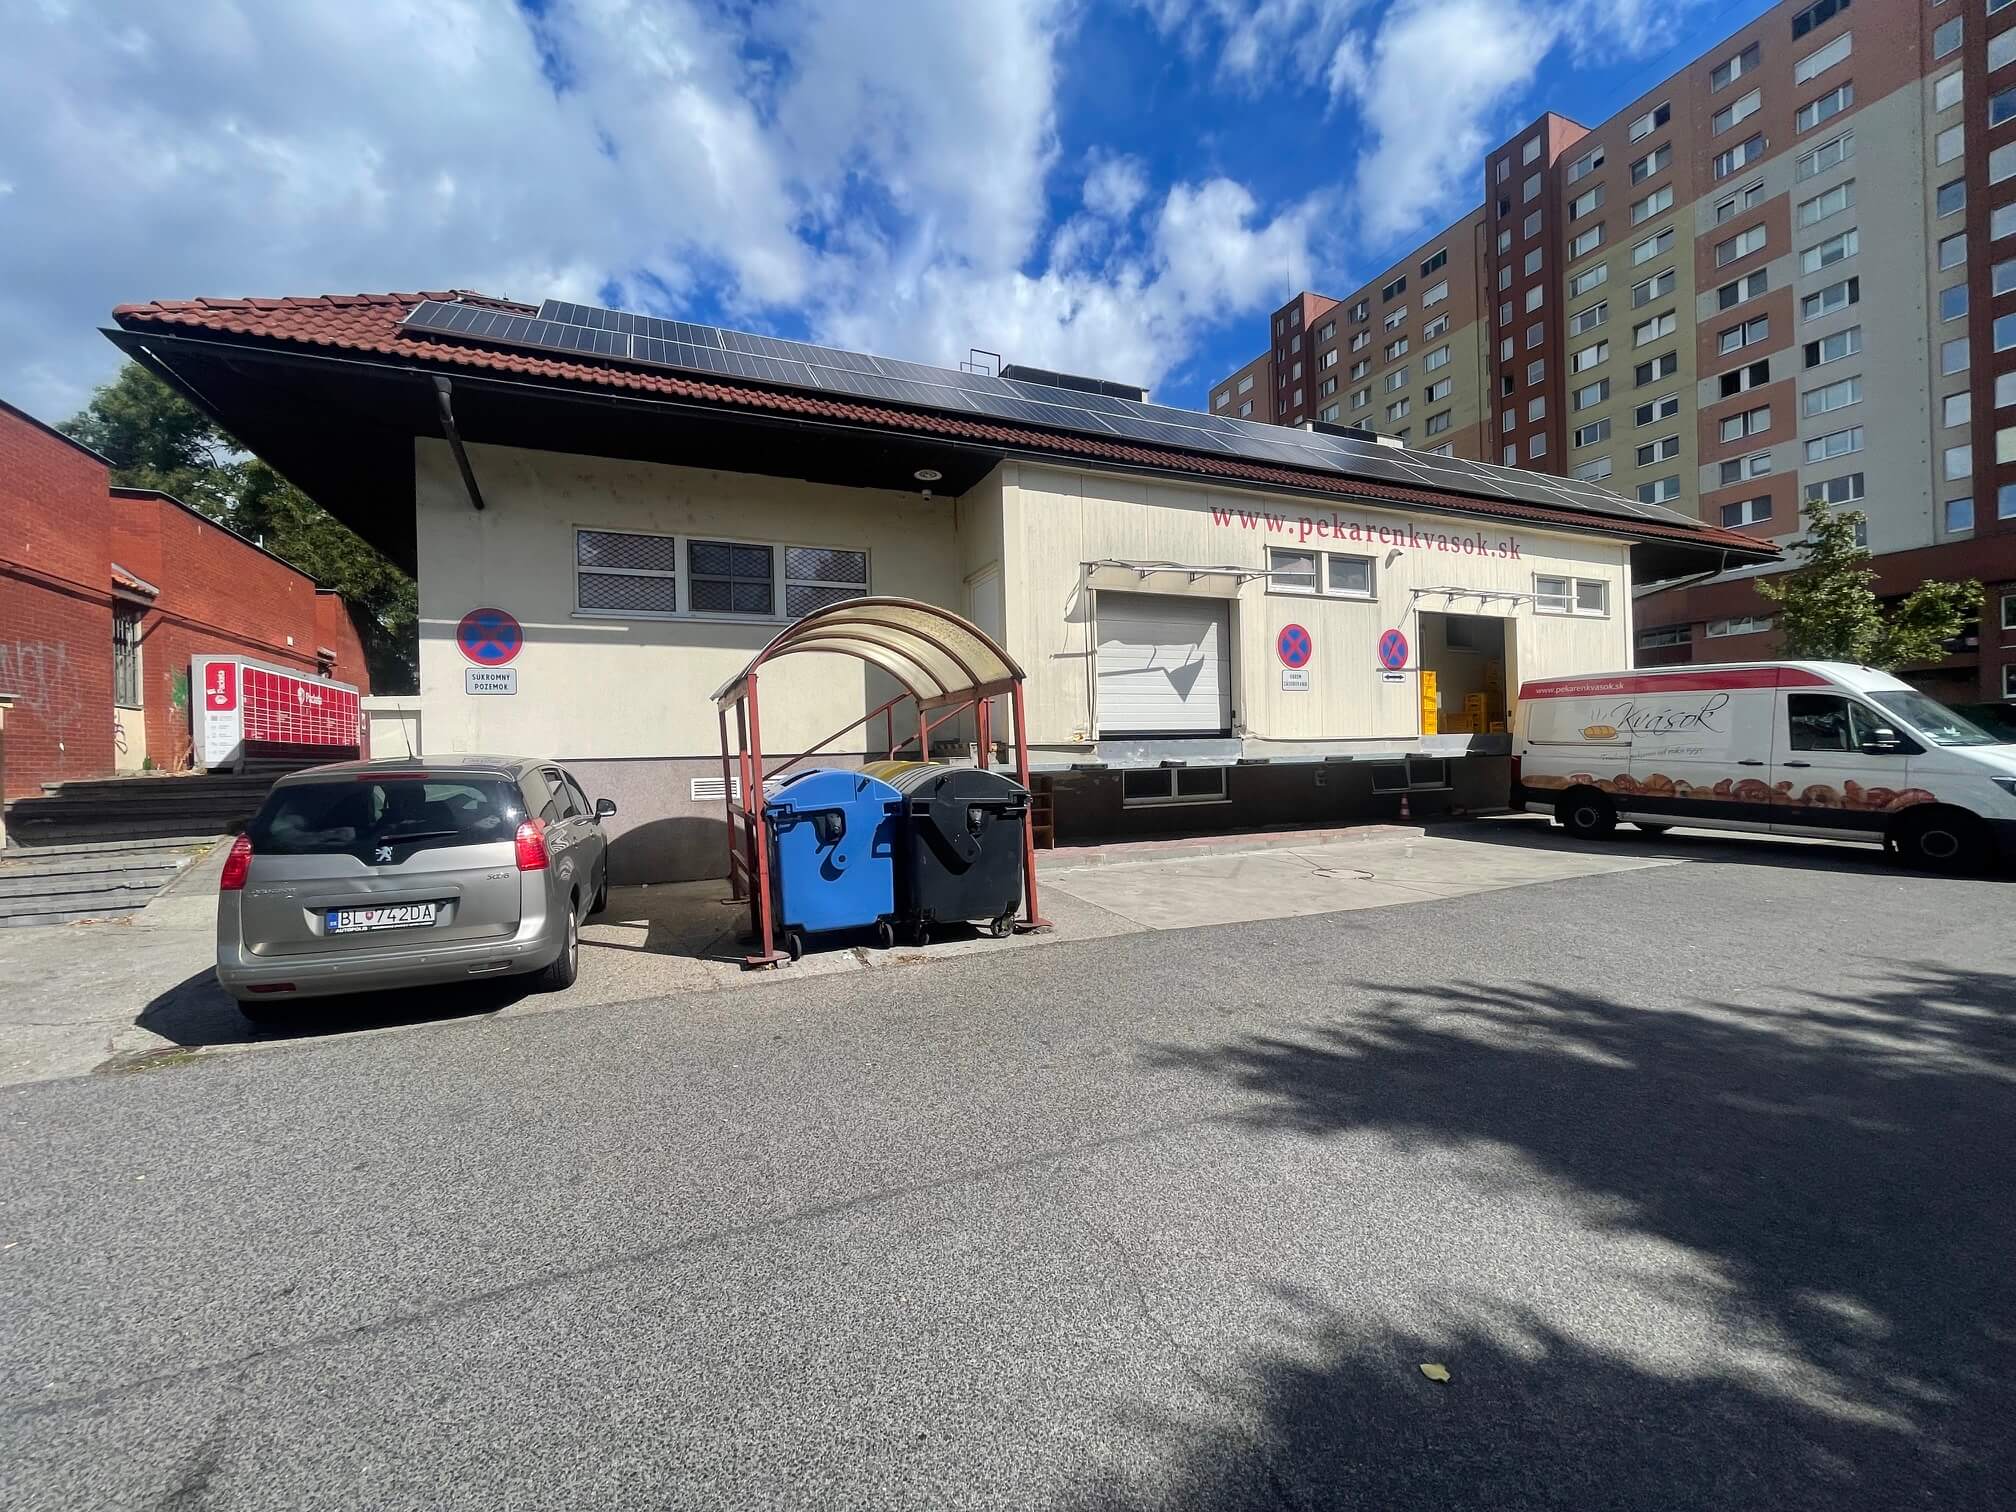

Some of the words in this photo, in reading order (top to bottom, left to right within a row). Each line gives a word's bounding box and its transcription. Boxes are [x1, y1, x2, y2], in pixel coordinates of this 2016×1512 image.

[1209, 506, 1522, 560] www.pekarenkvasok.sk
[1536, 681, 1625, 694] www.pekarenkvasok.sk
[340, 909, 363, 926] BL
[375, 903, 432, 923] 742DA
